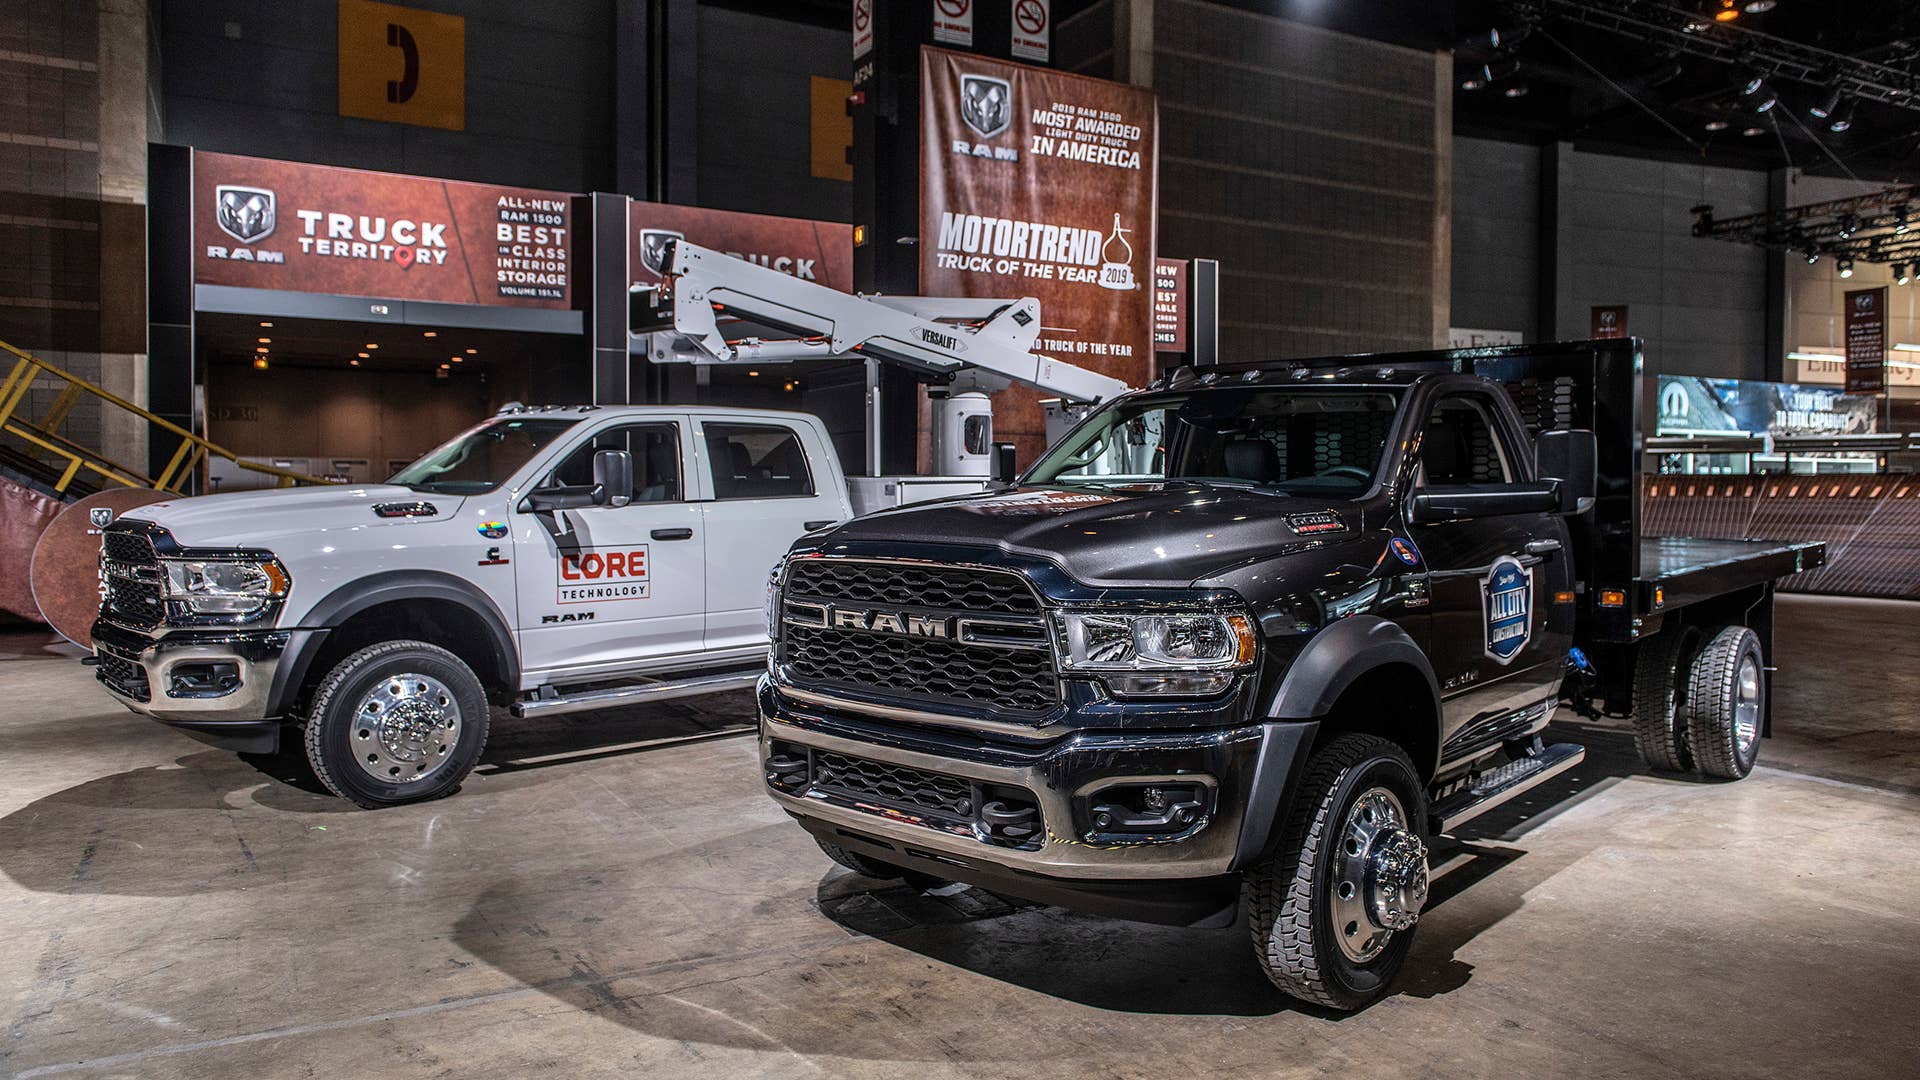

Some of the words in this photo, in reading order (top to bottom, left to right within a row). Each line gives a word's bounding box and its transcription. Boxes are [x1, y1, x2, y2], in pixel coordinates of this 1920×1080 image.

[1052, 102, 1075, 114] 2019
[1077, 106, 1097, 119] RAM
[1099, 110, 1122, 122] 1500
[1032, 109, 1074, 130] MOST
[1074, 117, 1141, 140] AWARDED
[1045, 127, 1074, 139] LIGHT
[1075, 132, 1098, 144] DUTY
[1100, 136, 1128, 148] TRUCK
[952, 140, 1018, 162] RAM
[1030, 135, 1054, 156] IN
[1056, 140, 1141, 170] AMERICA
[497, 196, 566, 213] ALL-NEW
[501, 210, 529, 221] RAM
[532, 213, 562, 225] 1500
[297, 210, 447, 248] TRUCK
[497, 223, 566, 246] BEST
[937, 212, 1103, 267] MOTORTREND
[207, 246, 284, 263] RAM
[298, 238, 448, 269] TERRITORY
[499, 246, 510, 254] IN
[512, 245, 566, 260] CLASS
[497, 258, 566, 272] INTERIOR
[936, 253, 994, 273] TRUCK
[996, 259, 1020, 276] OF
[1022, 262, 1053, 279] THE
[1057, 266, 1098, 284] YEAR
[497, 270, 566, 286] STORAGE
[1105, 267, 1127, 284] 2019
[1157, 279, 1175, 288] 500
[500, 286, 536, 296] VOLUME
[1157, 292, 1177, 302] EST
[1155, 303, 1177, 313] ABLE
[921, 328, 958, 350] VERSALIFT
[1044, 339, 1074, 353] TRUCK
[1076, 341, 1089, 353] OF
[1090, 343, 1107, 354] THE
[1109, 344, 1132, 357] YEAR
[562, 551, 646, 580] CORE
[562, 585, 646, 600] TECHNOLOGY
[1490, 594, 1507, 621] ALL
[1508, 588, 1526, 616] CITY
[542, 611, 595, 624] RAM
[835, 608, 950, 638] RAM
